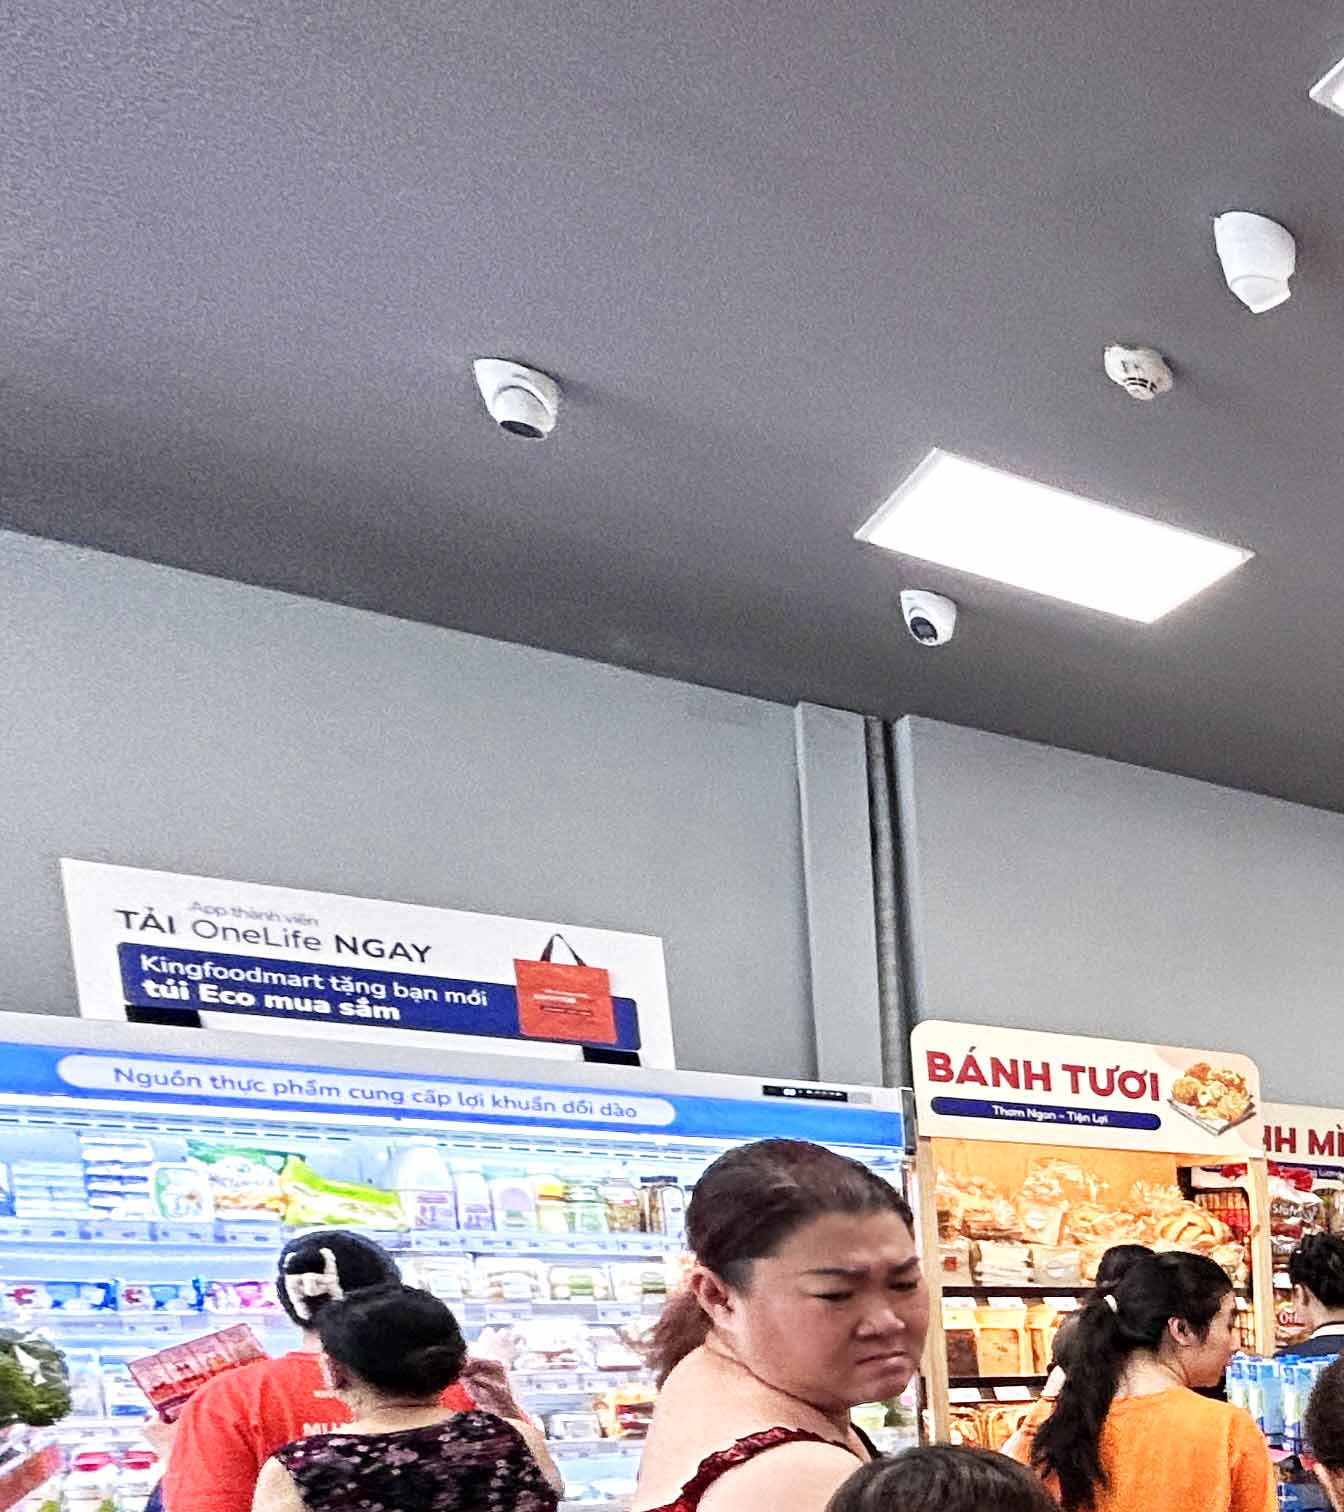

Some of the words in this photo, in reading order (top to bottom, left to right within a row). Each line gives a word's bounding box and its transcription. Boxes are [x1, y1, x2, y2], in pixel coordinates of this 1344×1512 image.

[116, 907, 176, 935] TẢI
[193, 920, 322, 951] OneLife
[335, 935, 431, 964] NGAY
[141, 954, 323, 990] Kingfoodmart
[327, 974, 386, 1001] tặng
[394, 977, 439, 1006] bạn
[445, 986, 489, 1007] mới
[143, 977, 190, 1000] túi
[199, 983, 256, 1006] Eco
[265, 995, 332, 1014] mua
[340, 996, 401, 1020] sắm
[349, 1088, 405, 1105] cung
[926, 1046, 1052, 1093] BÁNH
[1062, 1064, 1160, 1101] TƯƠI
[1308, 1124, 1344, 1157] MÌ
